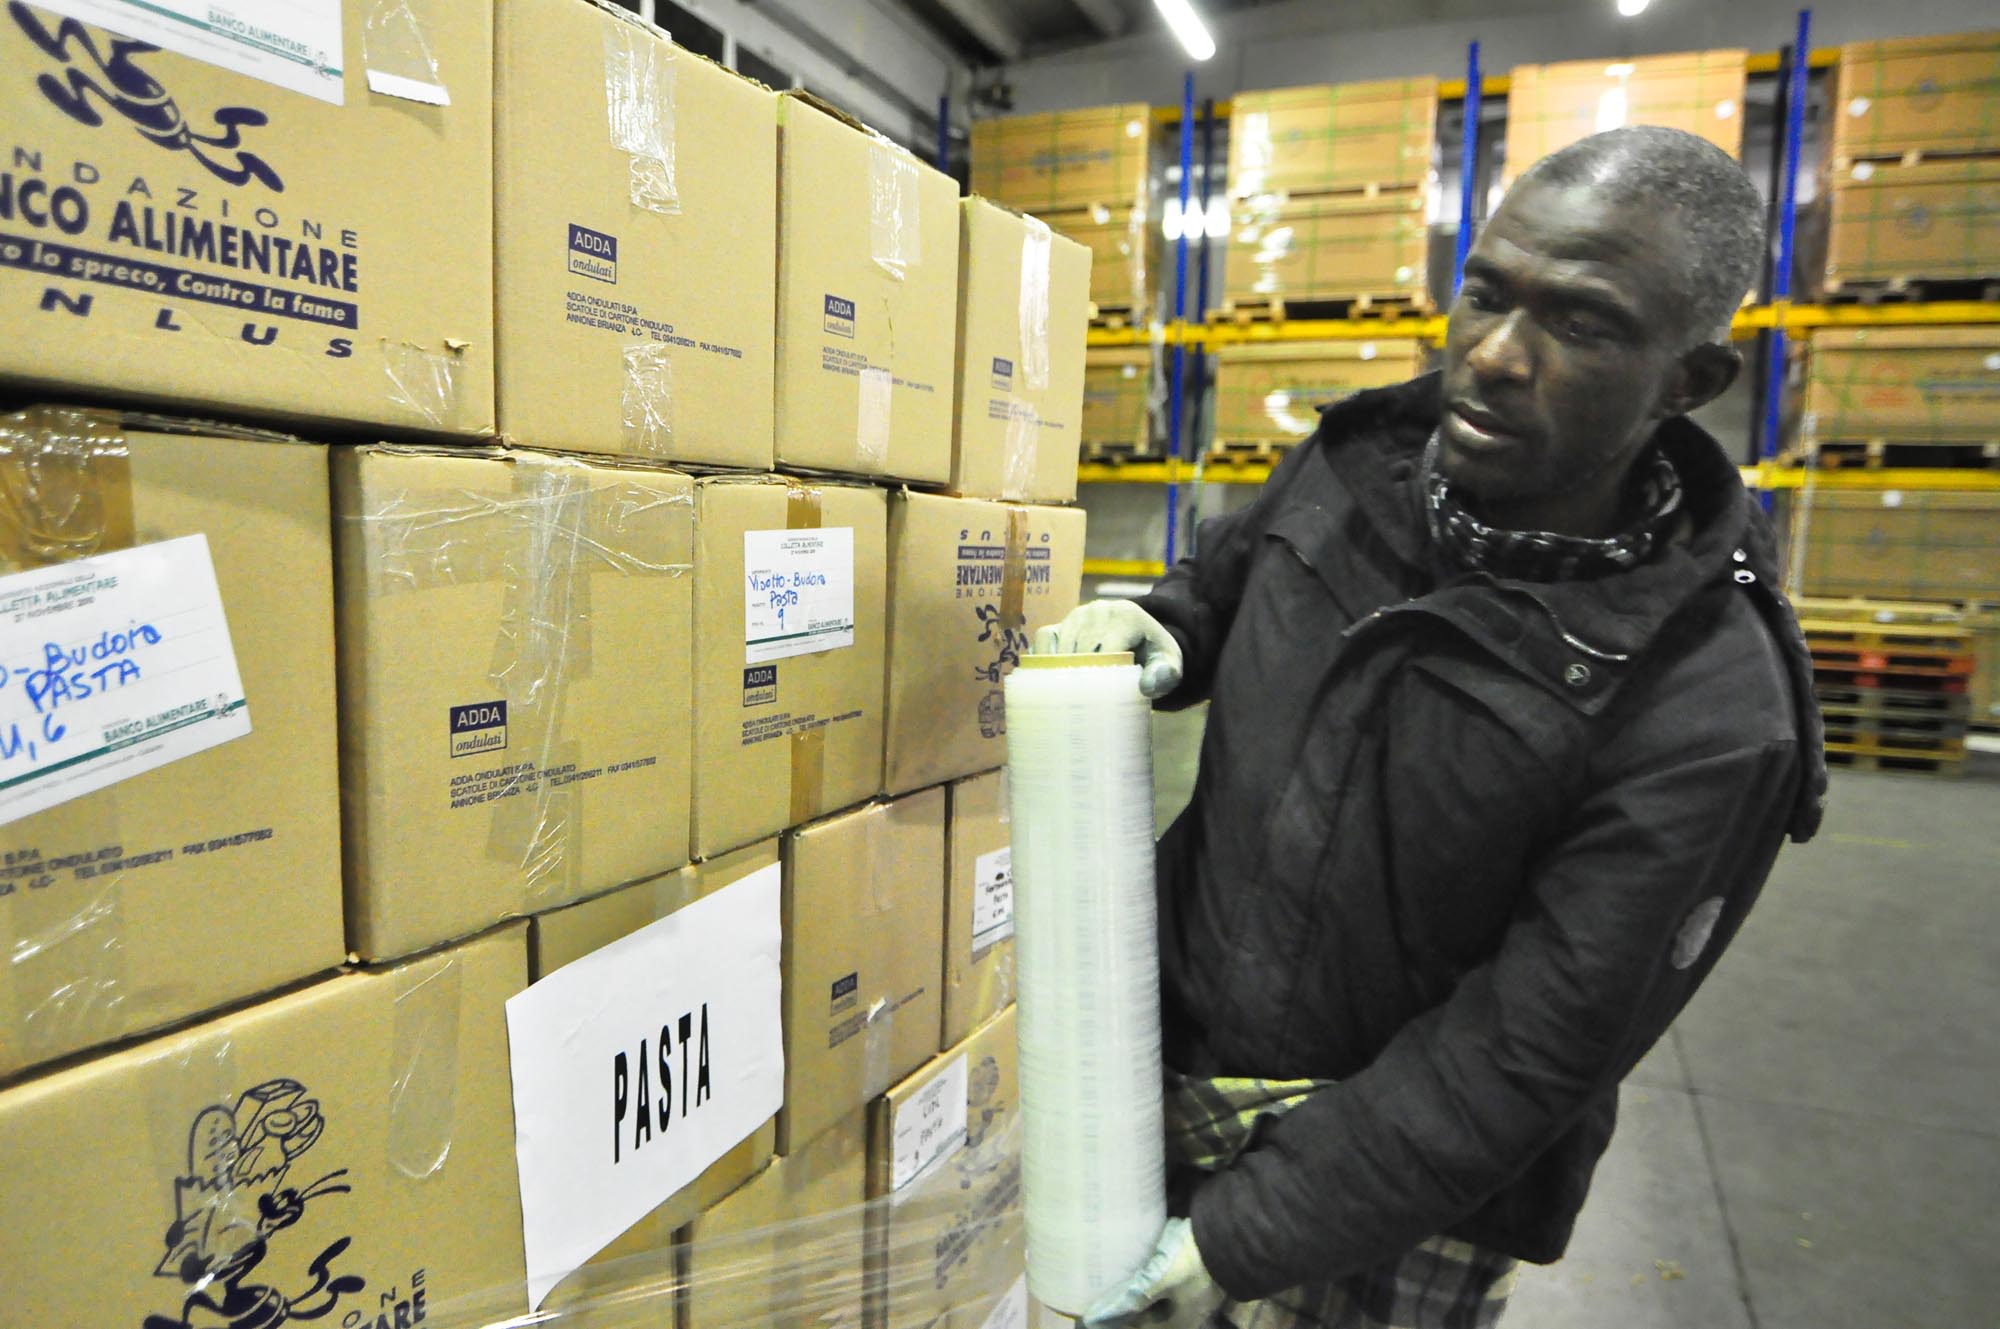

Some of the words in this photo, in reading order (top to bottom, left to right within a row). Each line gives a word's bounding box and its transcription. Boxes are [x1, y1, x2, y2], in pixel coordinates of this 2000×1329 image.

[108, 200, 358, 293] ALIMENTARE
[574, 230, 612, 256] ADDA
[572, 254, 613, 279] ondulati
[33, 242, 60, 267] lo
[70, 257, 166, 292] spreco,
[177, 273, 255, 304] Contro
[263, 289, 285, 310] la
[292, 294, 346, 321] fame
[566, 292, 586, 303] ADDA
[587, 296, 621, 311] ONDULATI
[828, 299, 852, 317] ADDA
[566, 302, 598, 317] SCATOLE
[599, 310, 607, 318] DI
[607, 311, 639, 326] CARTONE
[639, 319, 674, 334] ONDULATO
[597, 319, 627, 333] BRIANZA
[25, 658, 141, 714] PASTA
[747, 669, 774, 685] ADDA
[43, 711, 66, 744] 6
[103, 720, 144, 743] BANCO
[145, 698, 208, 729] ALIMENTARE
[457, 706, 501, 727] ADDA
[455, 732, 503, 752] ondulati
[450, 775, 473, 787] ADDA
[474, 766, 514, 782] ONDULATI
[450, 782, 487, 798] SCATOLE
[489, 781, 498, 789] DI
[450, 795, 487, 809] ANNONE
[614, 1003, 711, 1164] PASTA
